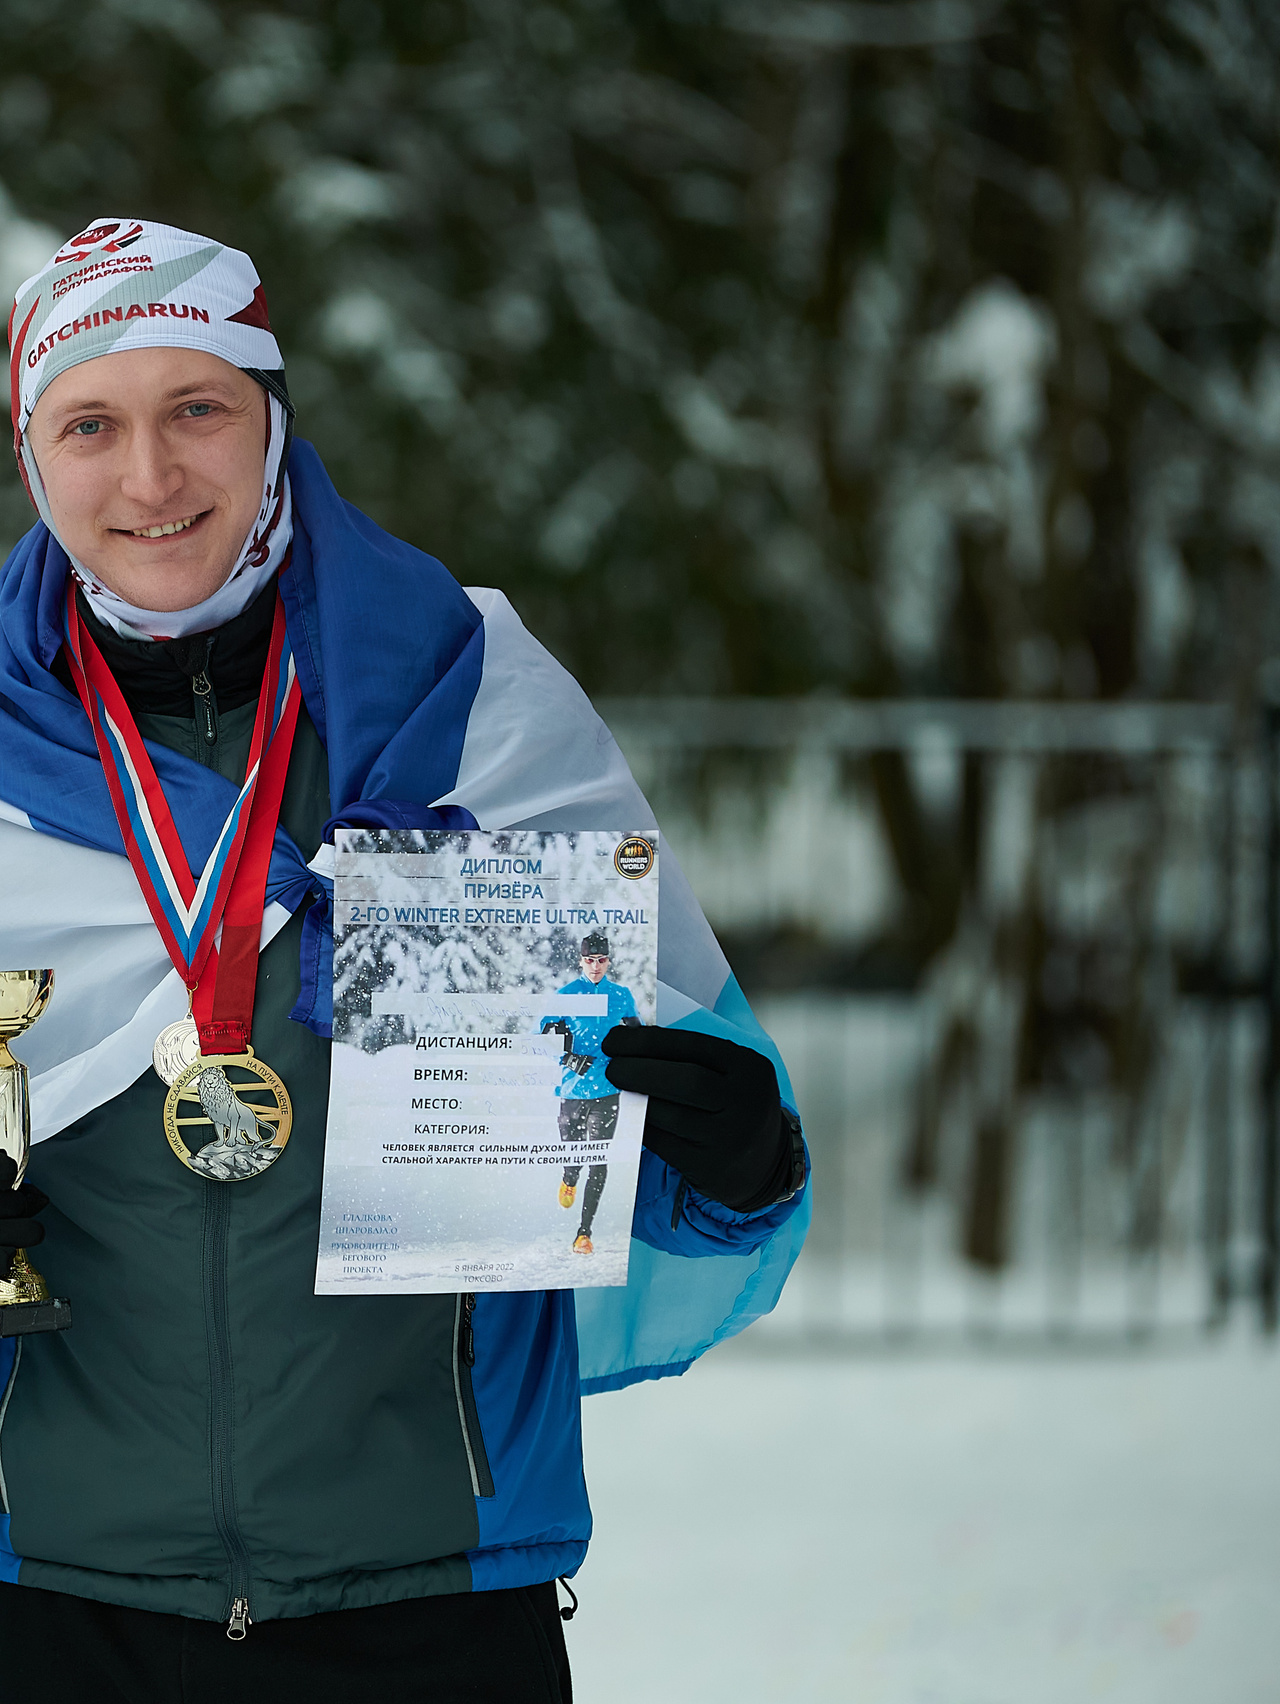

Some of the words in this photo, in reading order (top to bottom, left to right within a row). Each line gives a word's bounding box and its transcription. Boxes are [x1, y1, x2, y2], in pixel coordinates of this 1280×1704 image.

[52, 254, 152, 291] ГАТЧИНСКИЙ
[52, 265, 154, 300] ПОЛУМАРАФОН
[27, 303, 209, 368] GATCHINARUN
[460, 858, 542, 876] ДИПЛОМ
[464, 880, 544, 899] ПРИЗЁРА
[350, 907, 390, 924] 2-ГО
[394, 907, 460, 924] WINTER
[464, 908, 541, 924] EXTREME
[546, 908, 599, 925] ULTRA
[602, 909, 649, 925] TRAIL
[415, 1036, 512, 1050] ДИСТАНЦИЯ:
[414, 1069, 468, 1081] ВРЕМЯ:
[170, 1063, 204, 1100] СДАВАЙСЯ
[246, 1060, 258, 1070] НА
[258, 1066, 276, 1085] ПУТИ
[277, 1091, 288, 1115] МЕЧТЕ
[167, 1102, 175, 1113] НЕ
[411, 1098, 462, 1110] МЕСТО:
[485, 1100, 496, 1116] 2
[166, 1115, 184, 1154] НИКОГДА
[414, 1124, 489, 1135] КАТЕГОРИЯ:
[382, 1143, 425, 1152] ЧЕЛОВЕК
[427, 1144, 475, 1152] ЯВЛЯЕТСЯ
[479, 1144, 529, 1153] СИЛЬНЫМ
[530, 1144, 566, 1154] ДУХОМ
[580, 1142, 610, 1151] ИМЕЕТ
[382, 1154, 433, 1164] СТАЛЬНОЙ
[435, 1156, 483, 1165] ХАРАКТЕР
[485, 1157, 498, 1165] НА
[500, 1157, 527, 1165] ПУТИ
[537, 1156, 571, 1164] СВОИМ
[573, 1155, 608, 1165] ЦЕЛЯМ.
[343, 1213, 392, 1222] ГЛАДКОВА
[331, 1242, 400, 1250] РУКОВОДИТЕЛЬ
[342, 1254, 387, 1262] БЕГОВОГО
[343, 1266, 383, 1274] ПРОЕКТА
[454, 1264, 459, 1272] 8
[461, 1264, 494, 1272] ЯНВАРЯ
[495, 1263, 515, 1271] 2022
[464, 1275, 503, 1283] ТОКСОВО
